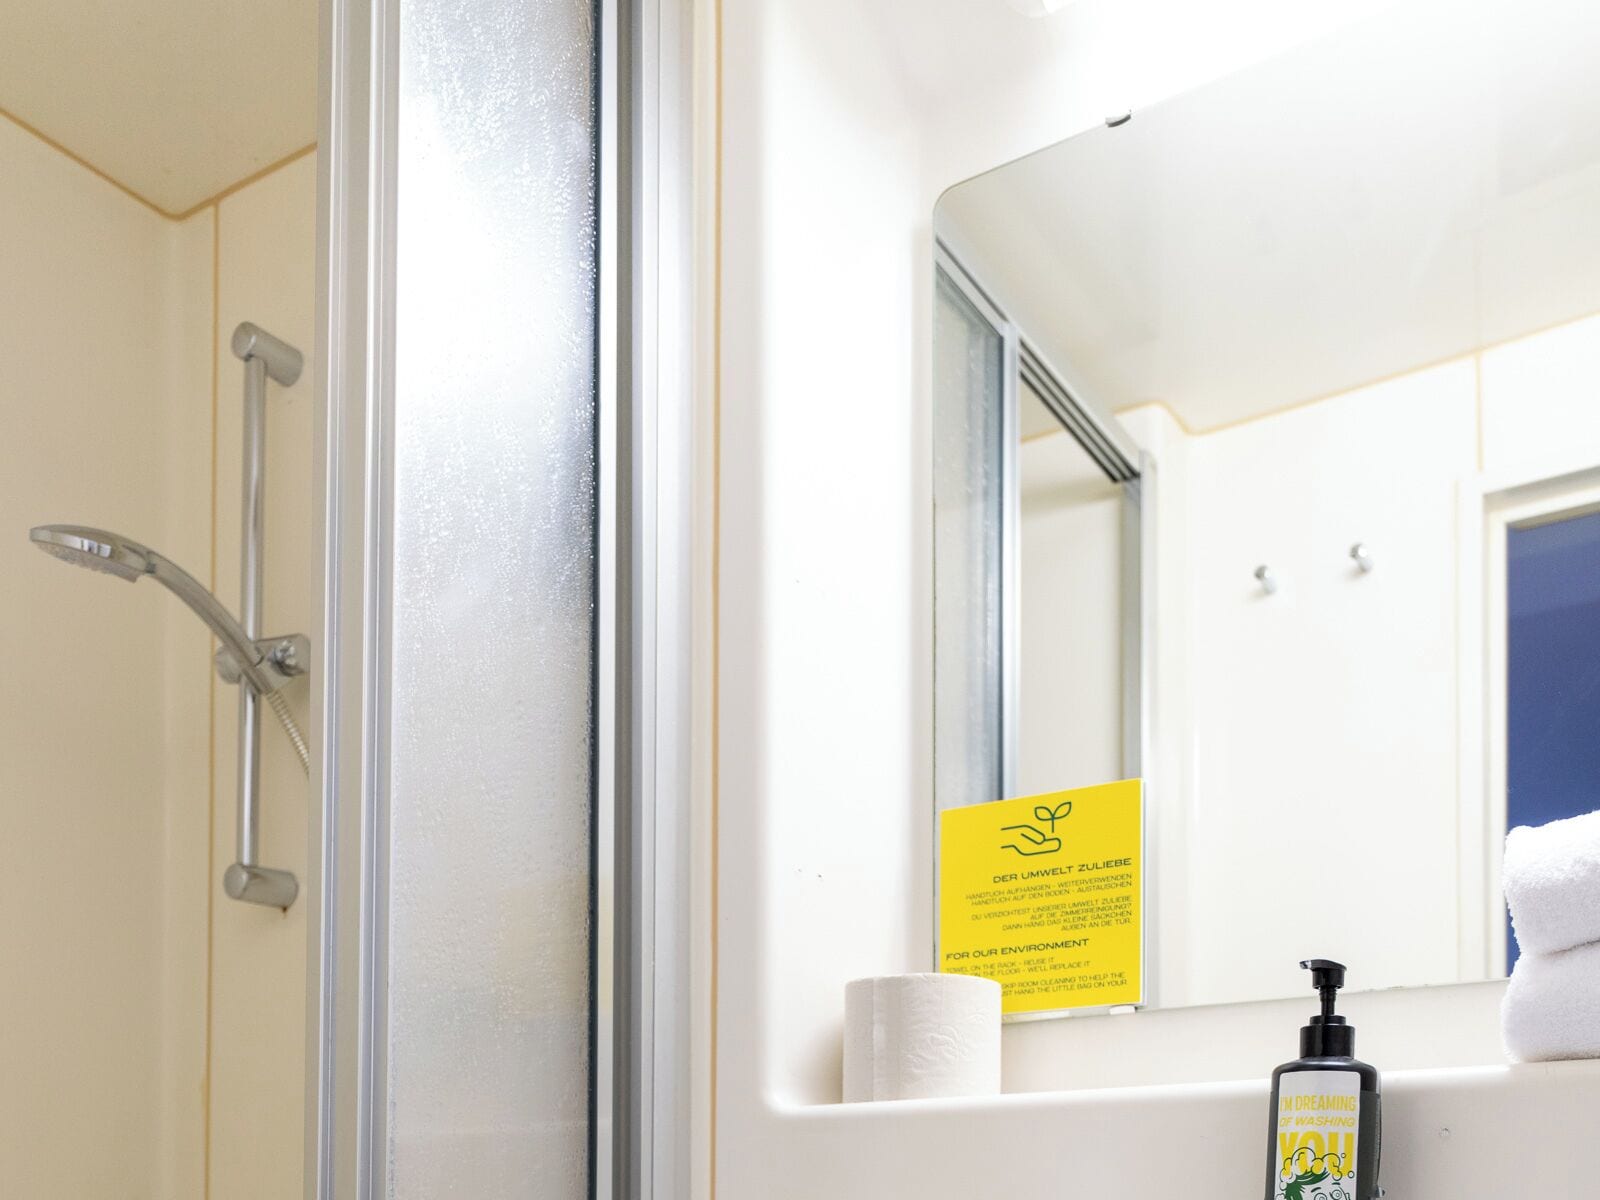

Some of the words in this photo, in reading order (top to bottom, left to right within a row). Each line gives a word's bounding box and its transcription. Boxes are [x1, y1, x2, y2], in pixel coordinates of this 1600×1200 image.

[992, 873, 1018, 884] DER
[1021, 865, 1074, 880] UMWELT
[1077, 857, 1132, 872] ZULIEBE
[966, 890, 1005, 900] HANDTUCH
[1057, 873, 1132, 888] WEITERVERWENDEN
[971, 895, 1011, 906] HANDTUCH
[1012, 893, 1025, 902] AUF
[1028, 891, 1044, 900] DEN
[1045, 887, 1070, 898] BODEN
[1077, 880, 1132, 894] AUSTAUSCHEN
[1068, 899, 1098, 909] UMWELT
[1002, 922, 1023, 931] DANN
[1063, 914, 1088, 924] KLEINE
[1030, 913, 1044, 921] AUF
[1088, 920, 1099, 929] AN
[1101, 919, 1112, 928] DIE
[946, 951, 970, 961] FOR
[972, 948, 998, 959] OUR
[1000, 938, 1090, 956] ENVIRONMENT
[970, 964, 981, 972] ON
[983, 962, 997, 970] THE
[997, 961, 1016, 969] RACK
[997, 967, 1020, 976] FLOOR
[1049, 961, 1082, 970] REPLACE
[1017, 980, 1039, 988] ROOM
[1039, 976, 1076, 986] CLEANING
[1078, 975, 1088, 983] TO
[1089, 973, 1109, 982] HELP
[1110, 971, 1126, 980] THE
[1093, 981, 1105, 989] ON
[1107, 979, 1128, 988] YOUR
[1295, 1094, 1357, 1112] DREAMING
[1279, 1117, 1292, 1127] OF
[1295, 1116, 1356, 1127] WASHING
[1279, 1130, 1355, 1177] YOU
